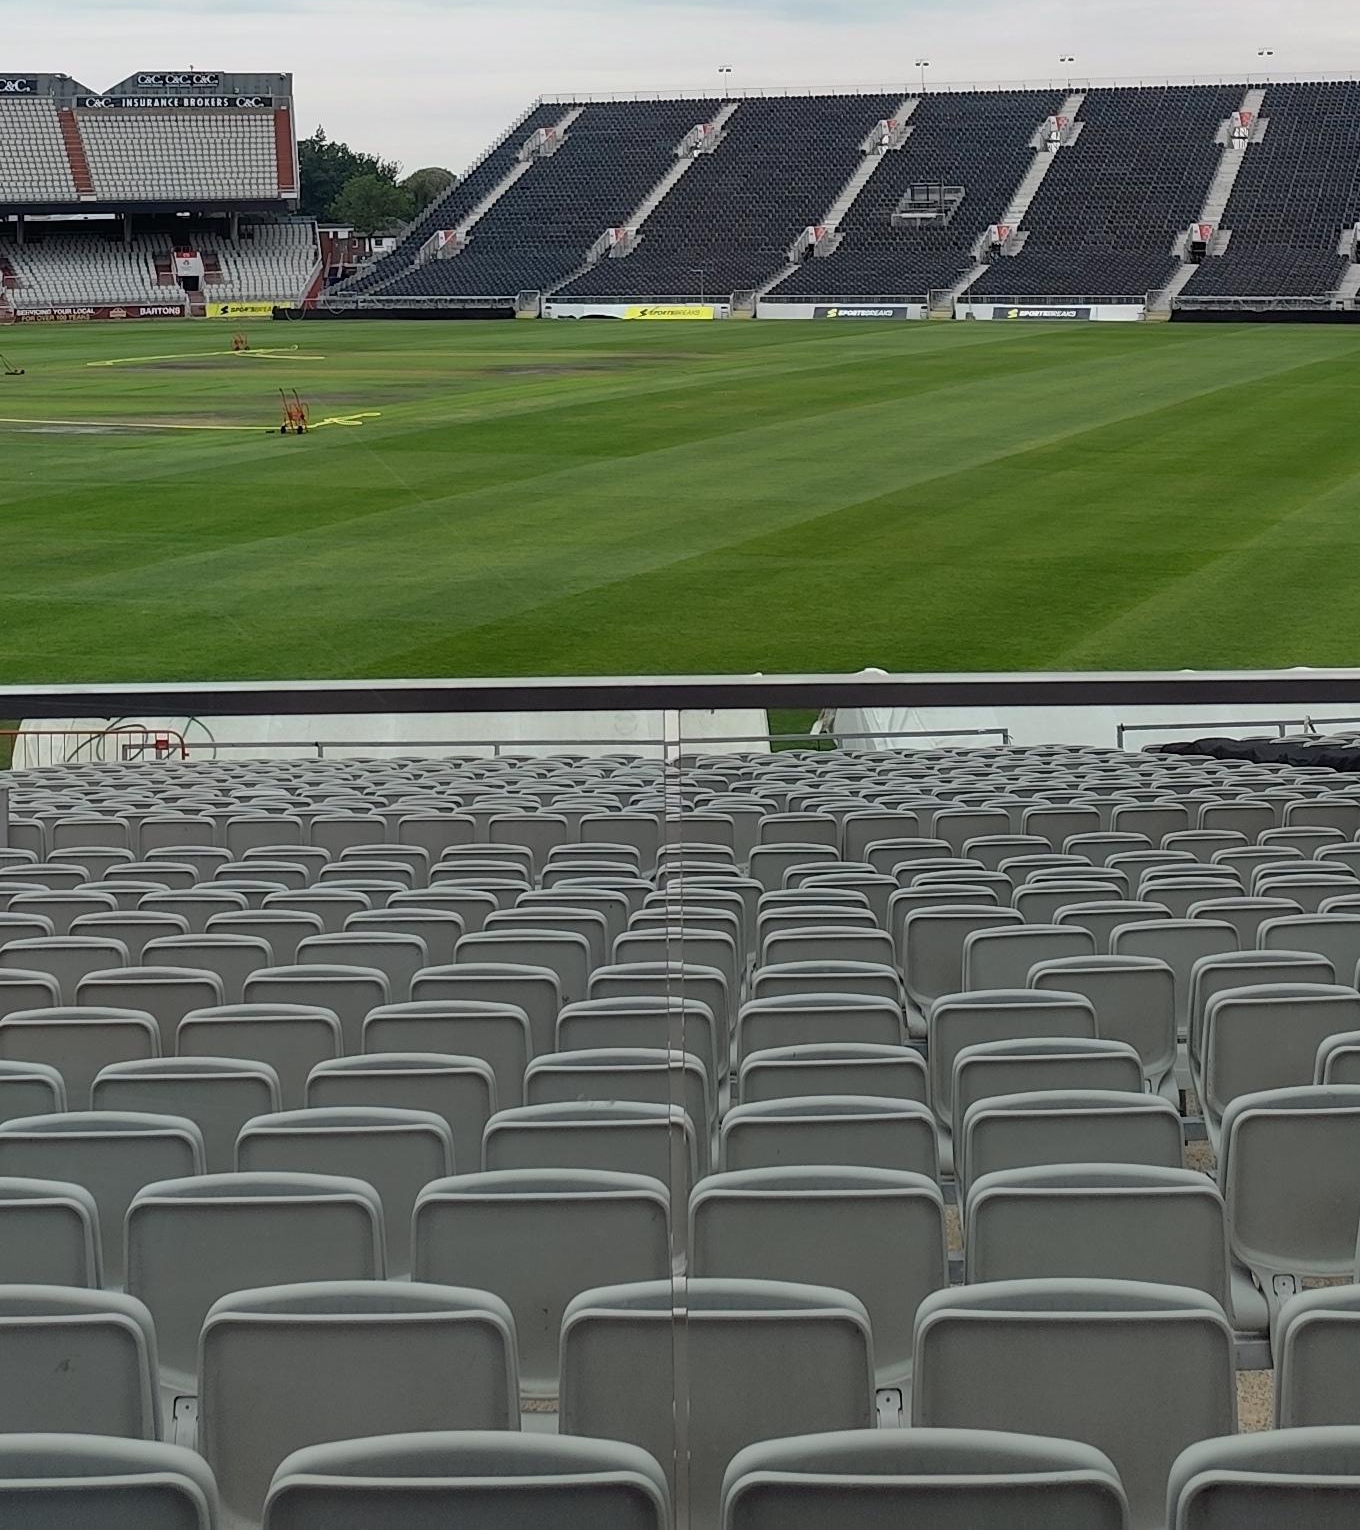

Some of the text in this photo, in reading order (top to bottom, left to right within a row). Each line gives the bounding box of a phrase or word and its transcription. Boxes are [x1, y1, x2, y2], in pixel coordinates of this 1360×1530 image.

[122, 98, 179, 107] INSURANCE
[184, 98, 229, 107] BROKERS
[139, 306, 180, 316] BARTONS
